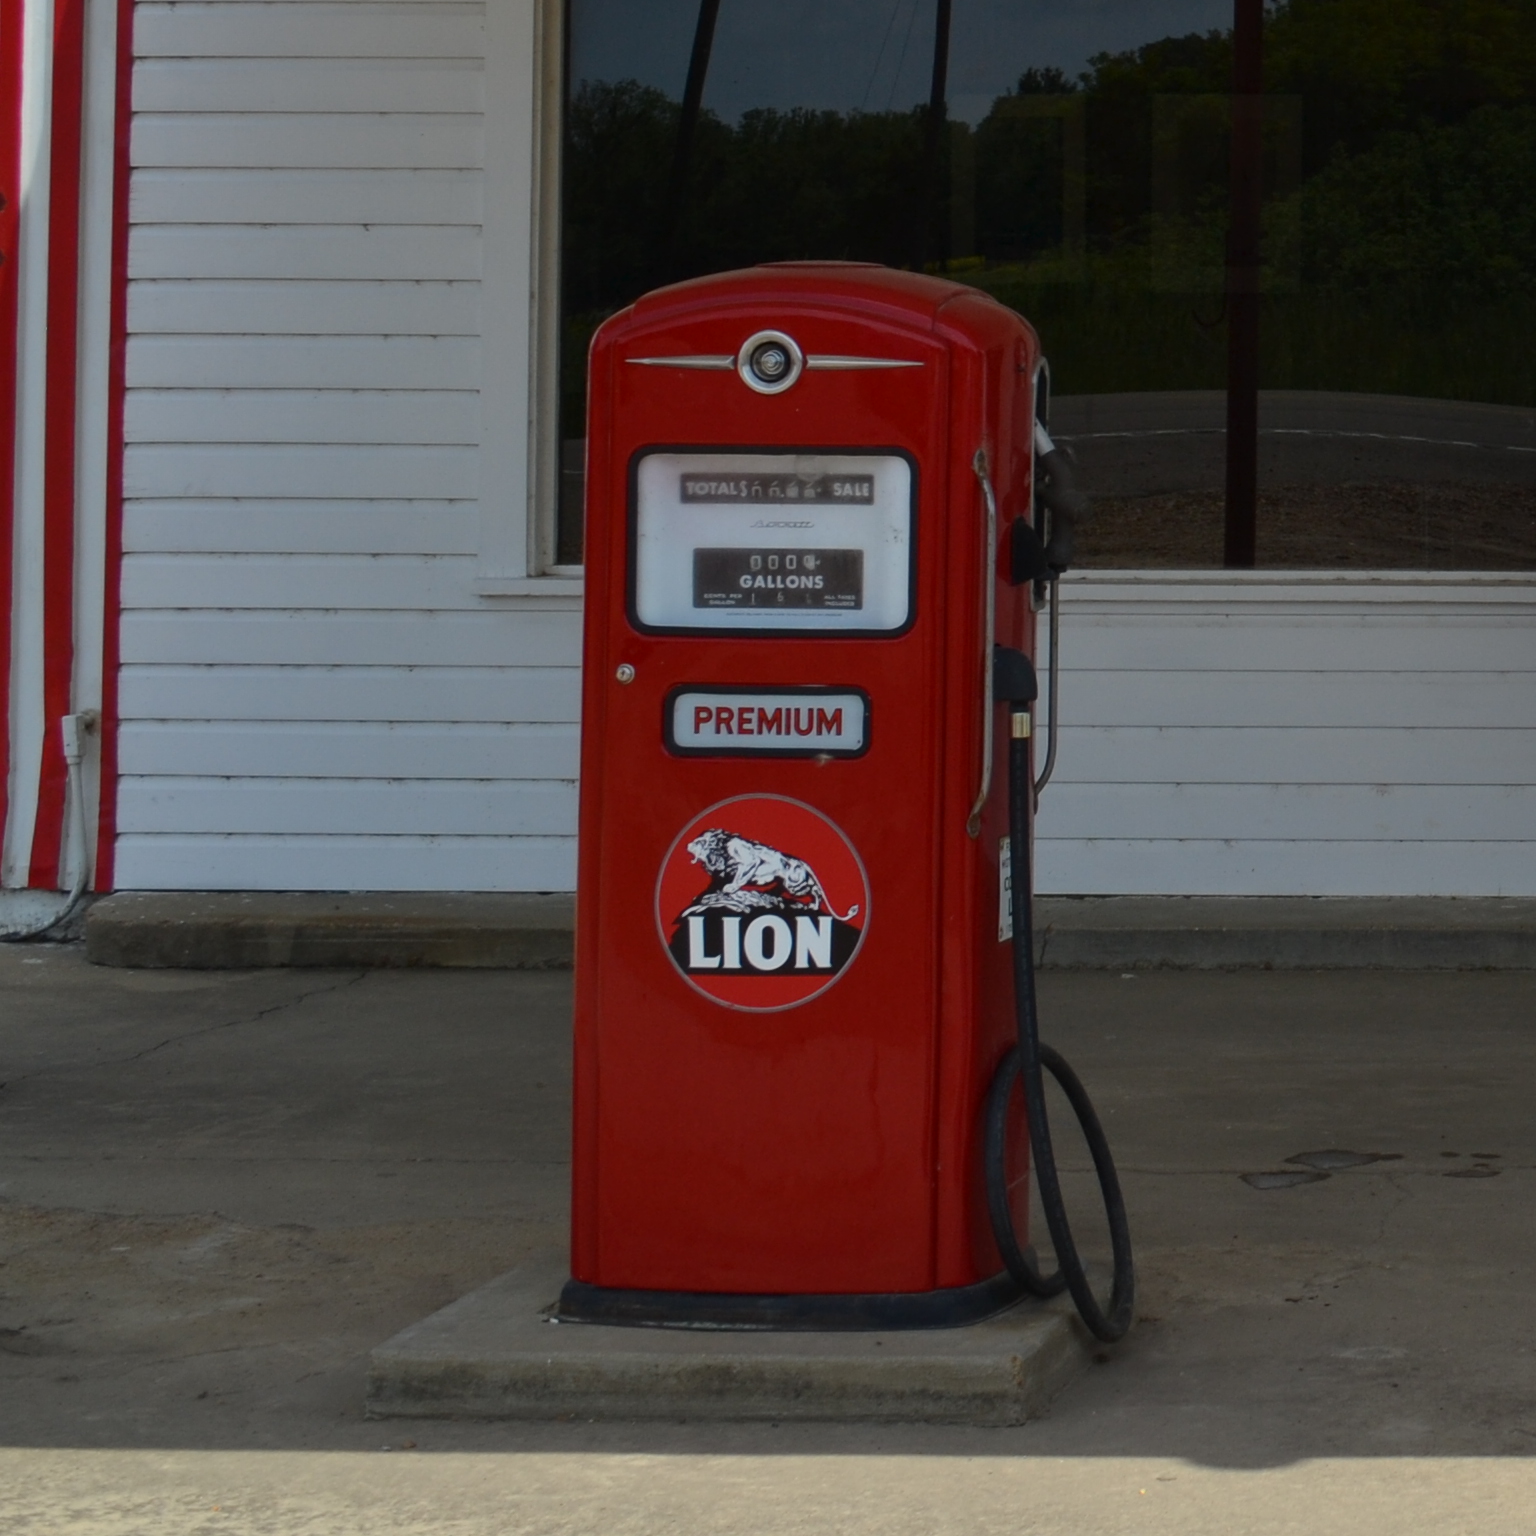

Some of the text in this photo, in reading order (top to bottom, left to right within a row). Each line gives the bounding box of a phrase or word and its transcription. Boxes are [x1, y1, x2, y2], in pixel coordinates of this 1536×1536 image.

[685, 481, 738, 496] TOTAL
[833, 482, 870, 497] SALE
[739, 574, 824, 589] GALLONS
[693, 705, 844, 736] PREMIUM
[687, 914, 834, 971] LION
